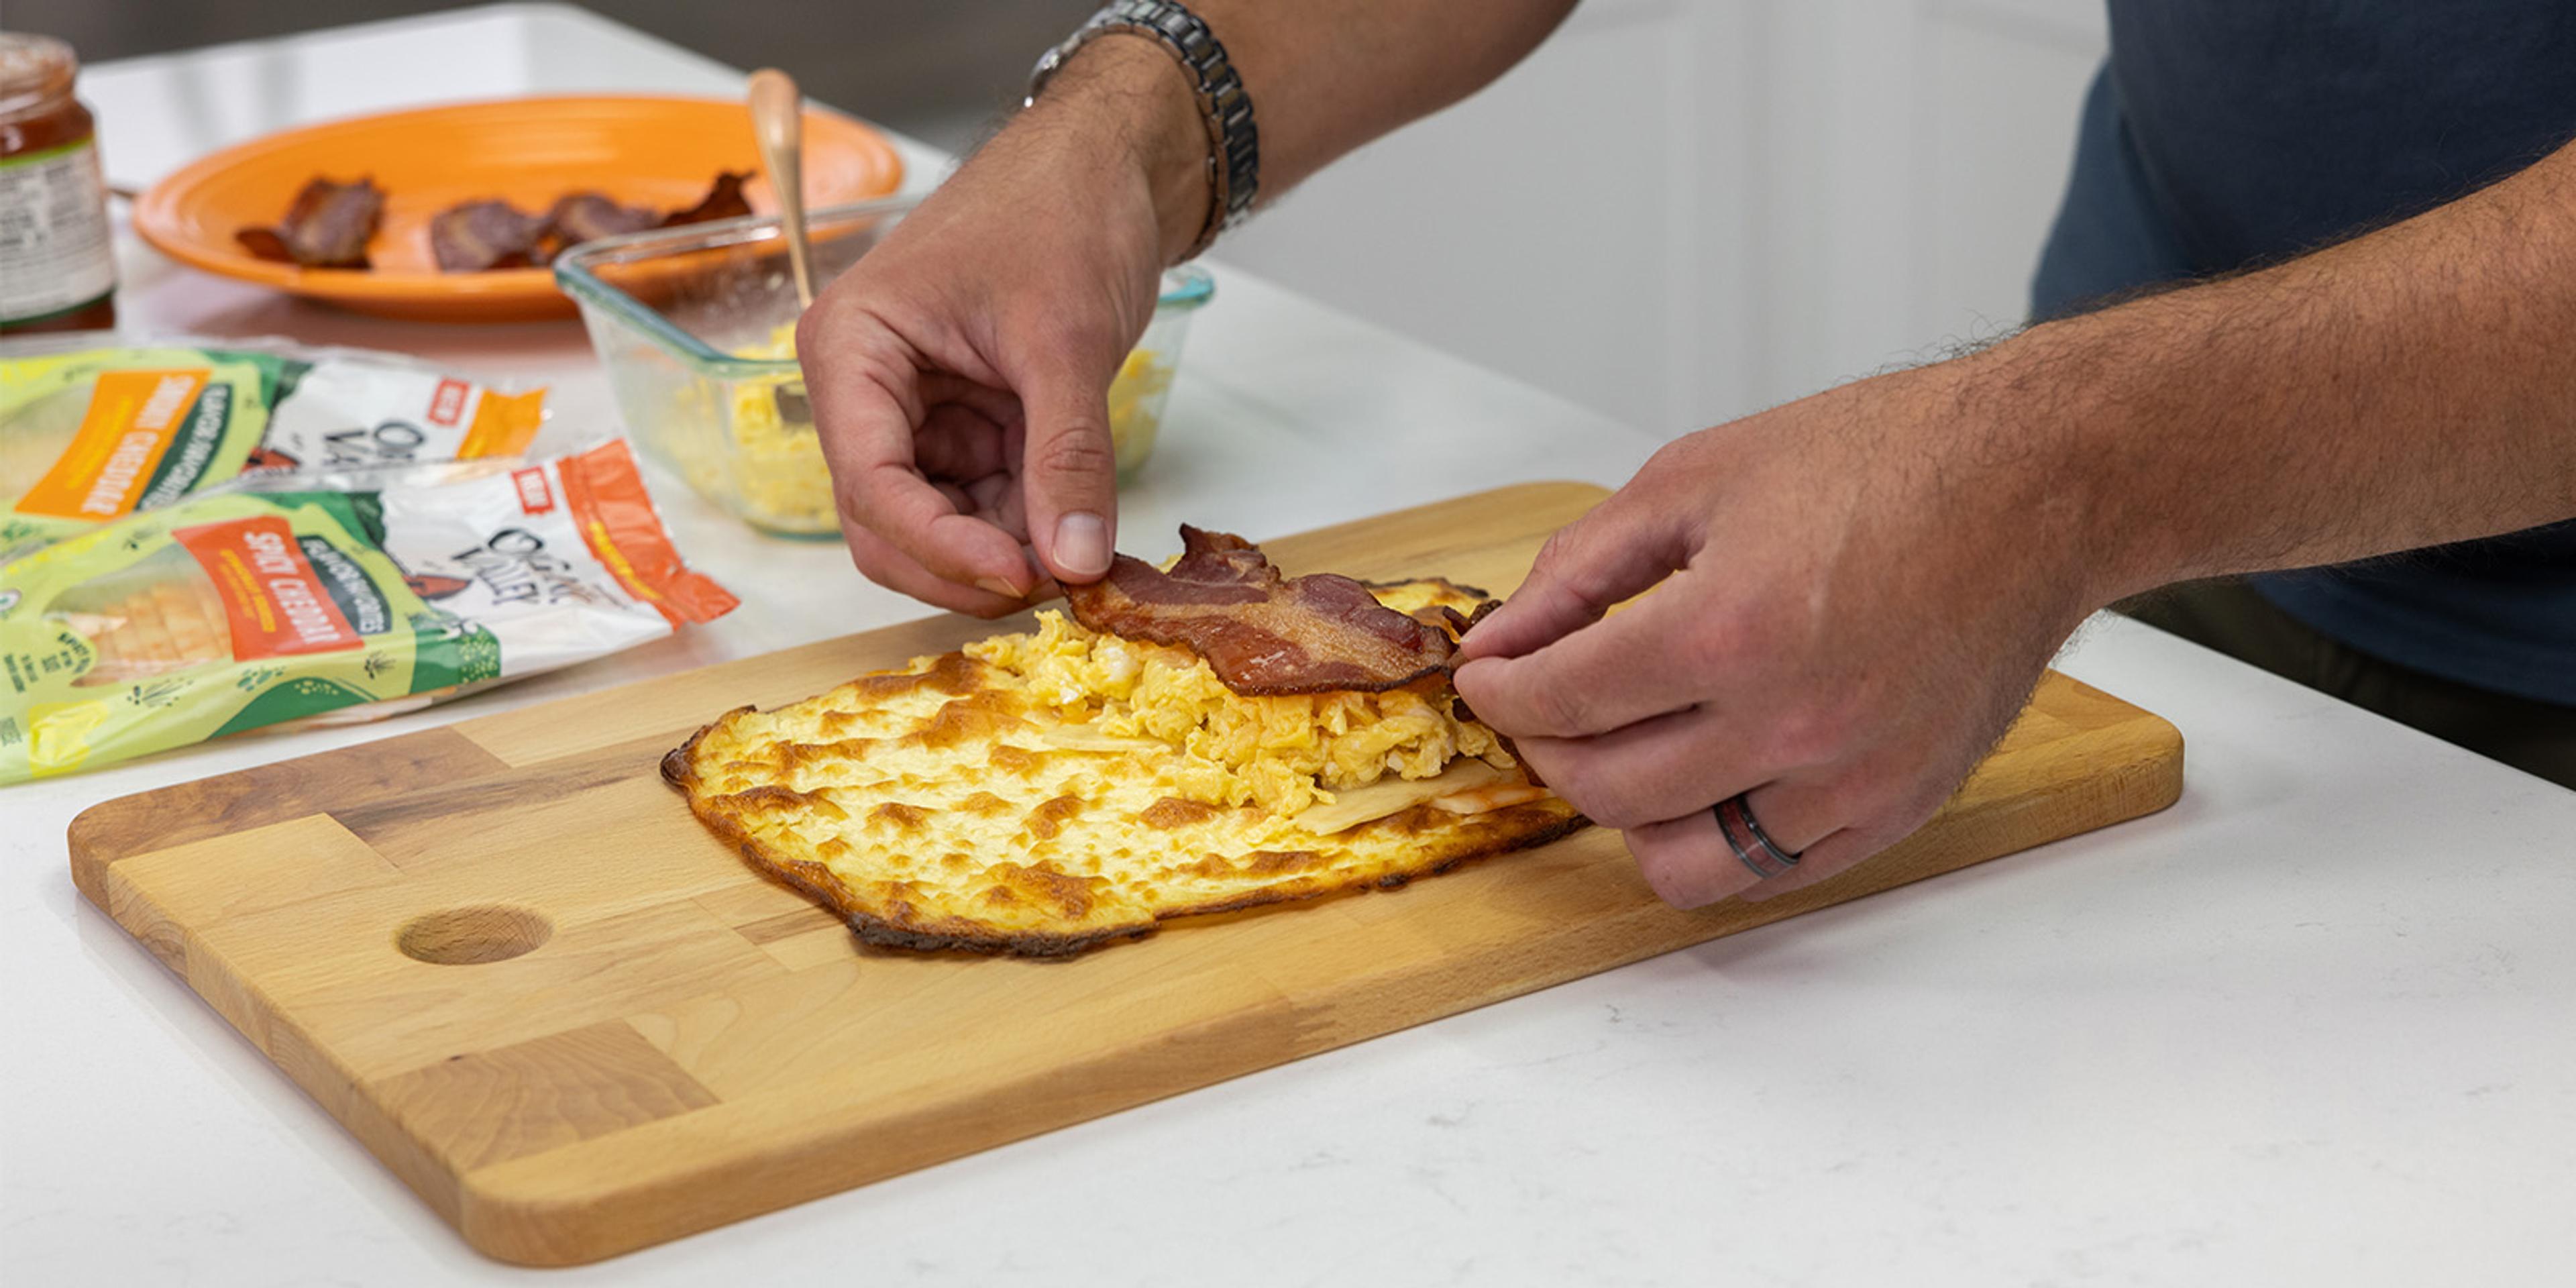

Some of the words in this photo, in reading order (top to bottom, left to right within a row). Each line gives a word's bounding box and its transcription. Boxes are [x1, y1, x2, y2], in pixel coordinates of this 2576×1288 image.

[80, 431, 159, 515] CHEDDAR
[244, 531, 299, 574] SPICY
[269, 578, 341, 645] CHEDDAR
